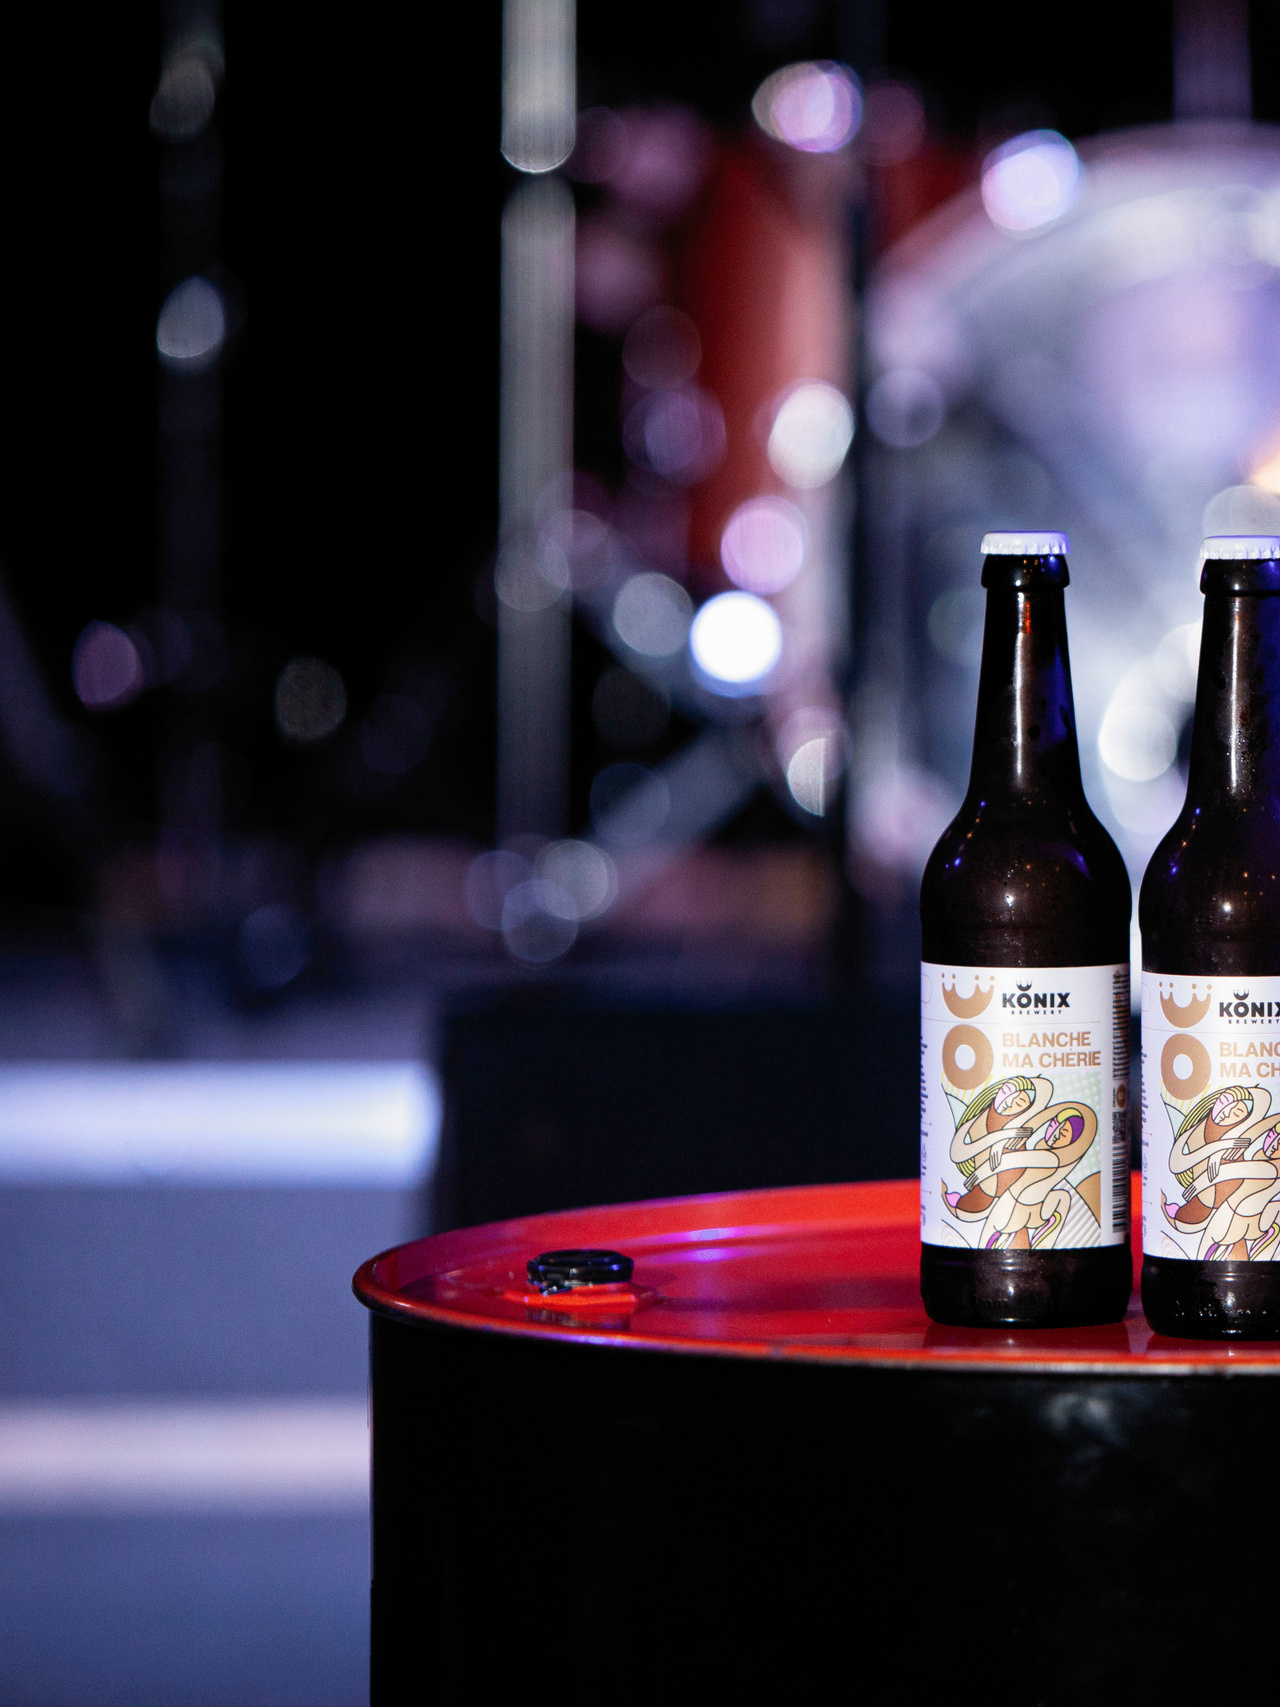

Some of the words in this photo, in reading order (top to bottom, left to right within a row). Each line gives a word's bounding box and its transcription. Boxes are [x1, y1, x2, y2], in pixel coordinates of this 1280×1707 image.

[1002, 1031, 1091, 1048] BLANCHE
[1002, 1052, 1033, 1069] MA
[1038, 1048, 1101, 1068] CHÉRIE
[1220, 1061, 1251, 1078] MA
